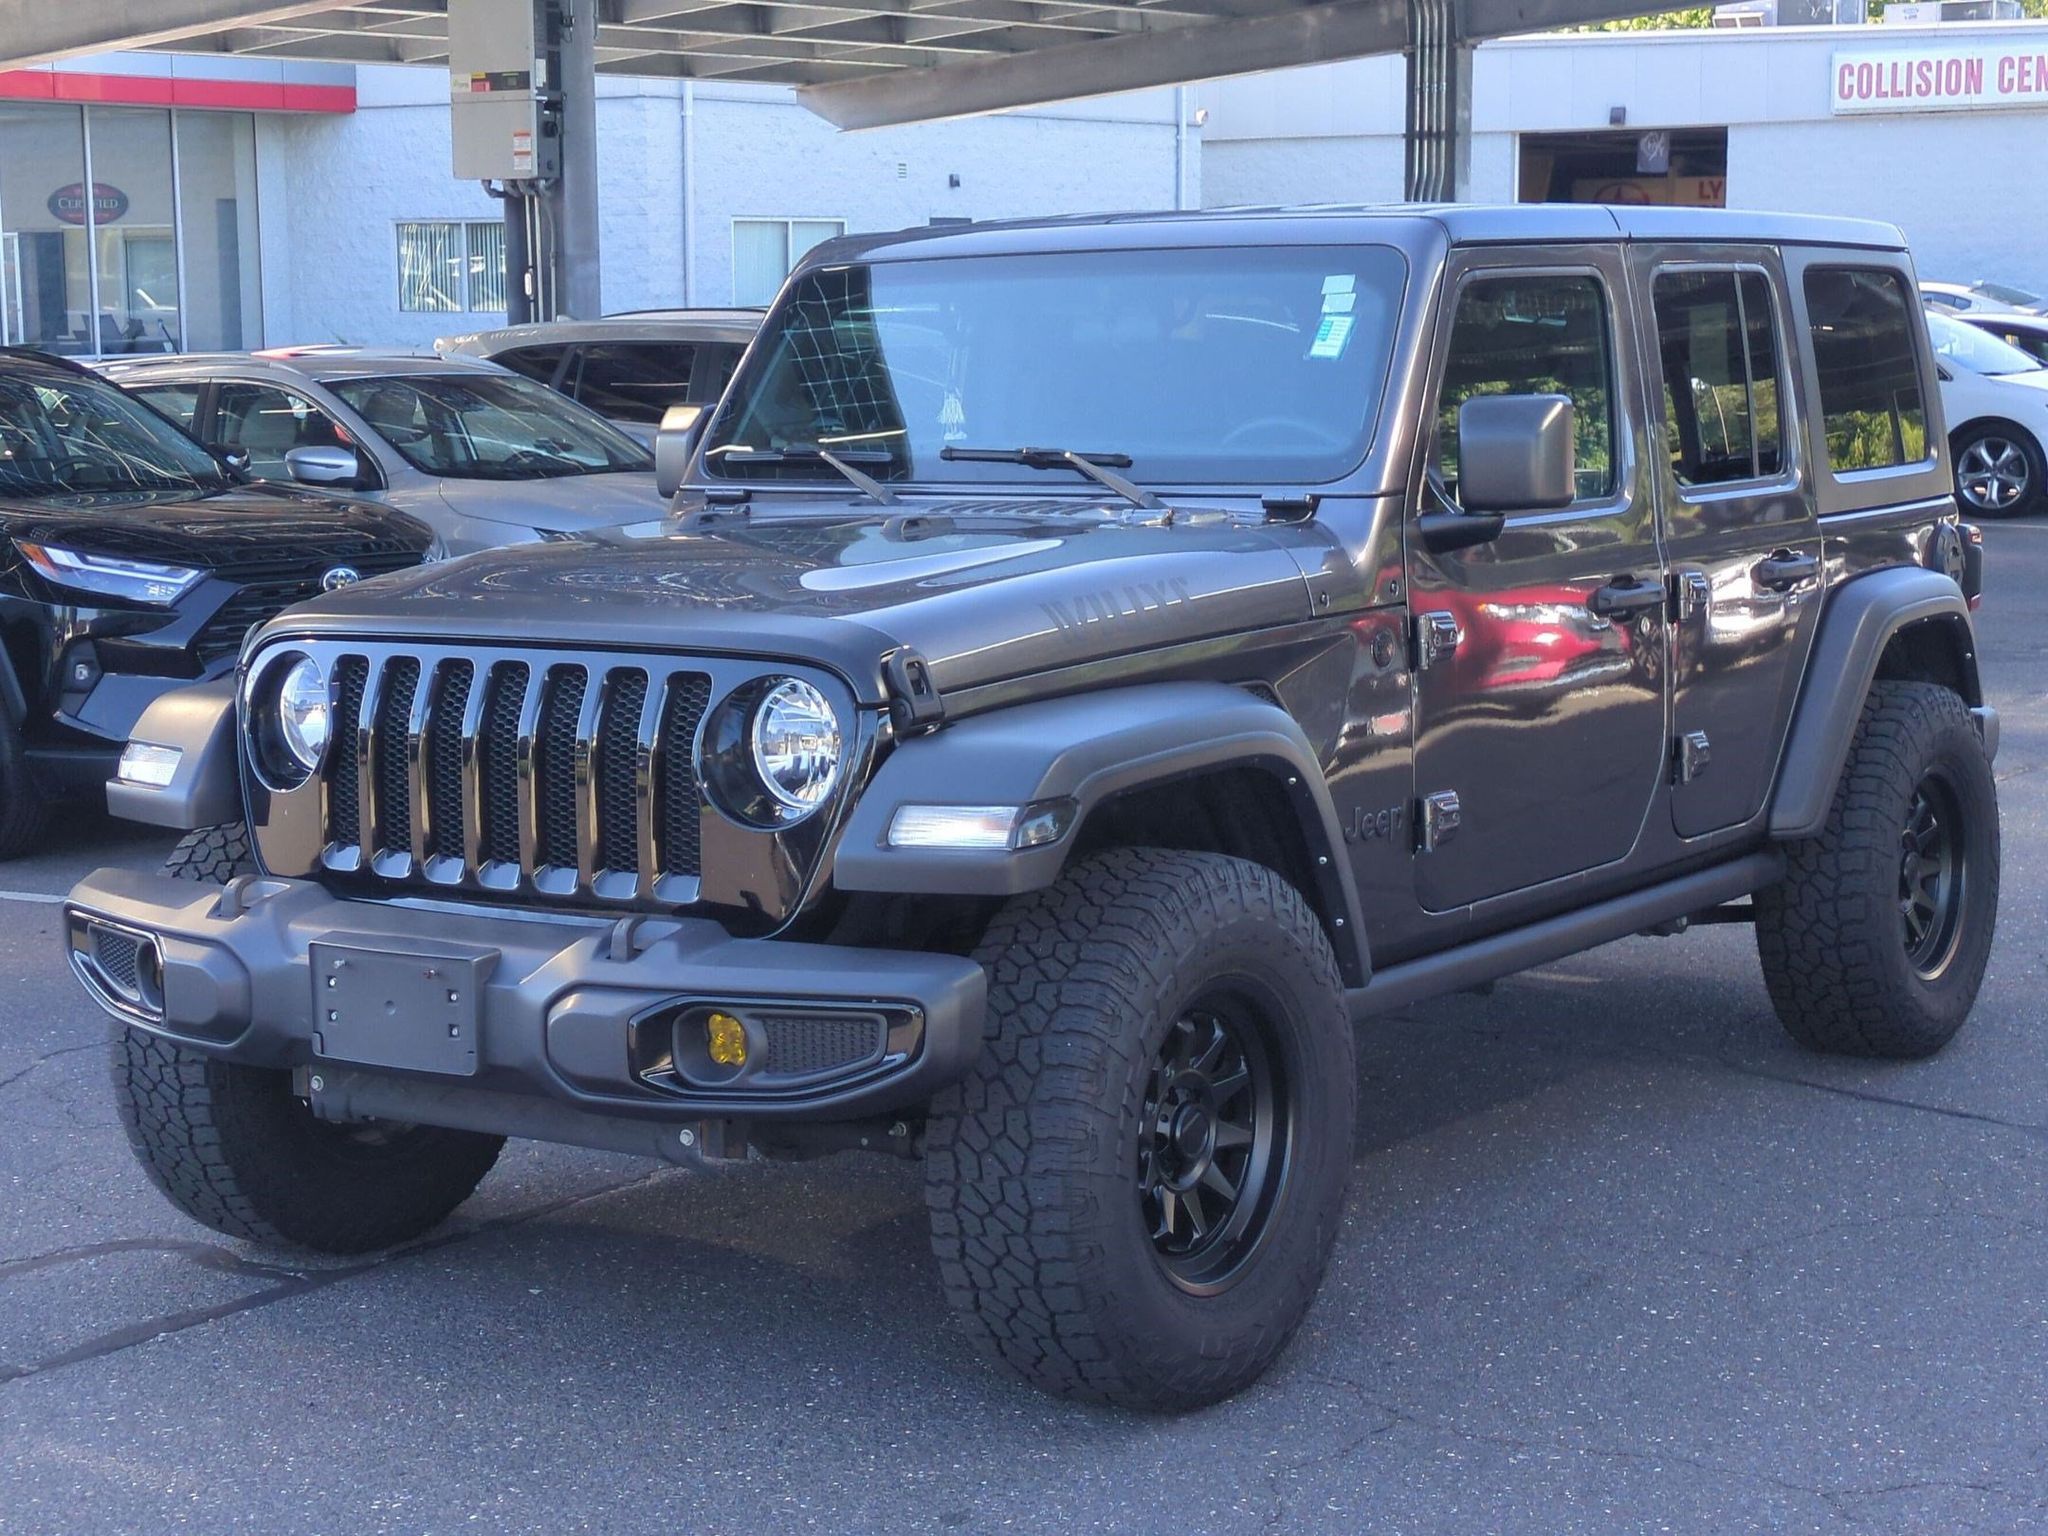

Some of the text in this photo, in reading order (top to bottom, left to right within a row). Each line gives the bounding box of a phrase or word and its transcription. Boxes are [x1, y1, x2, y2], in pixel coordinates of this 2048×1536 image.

[1838, 58, 1983, 100] COLLISION
[58, 197, 119, 209] CERIED
[1344, 805, 1404, 843] Jeep
